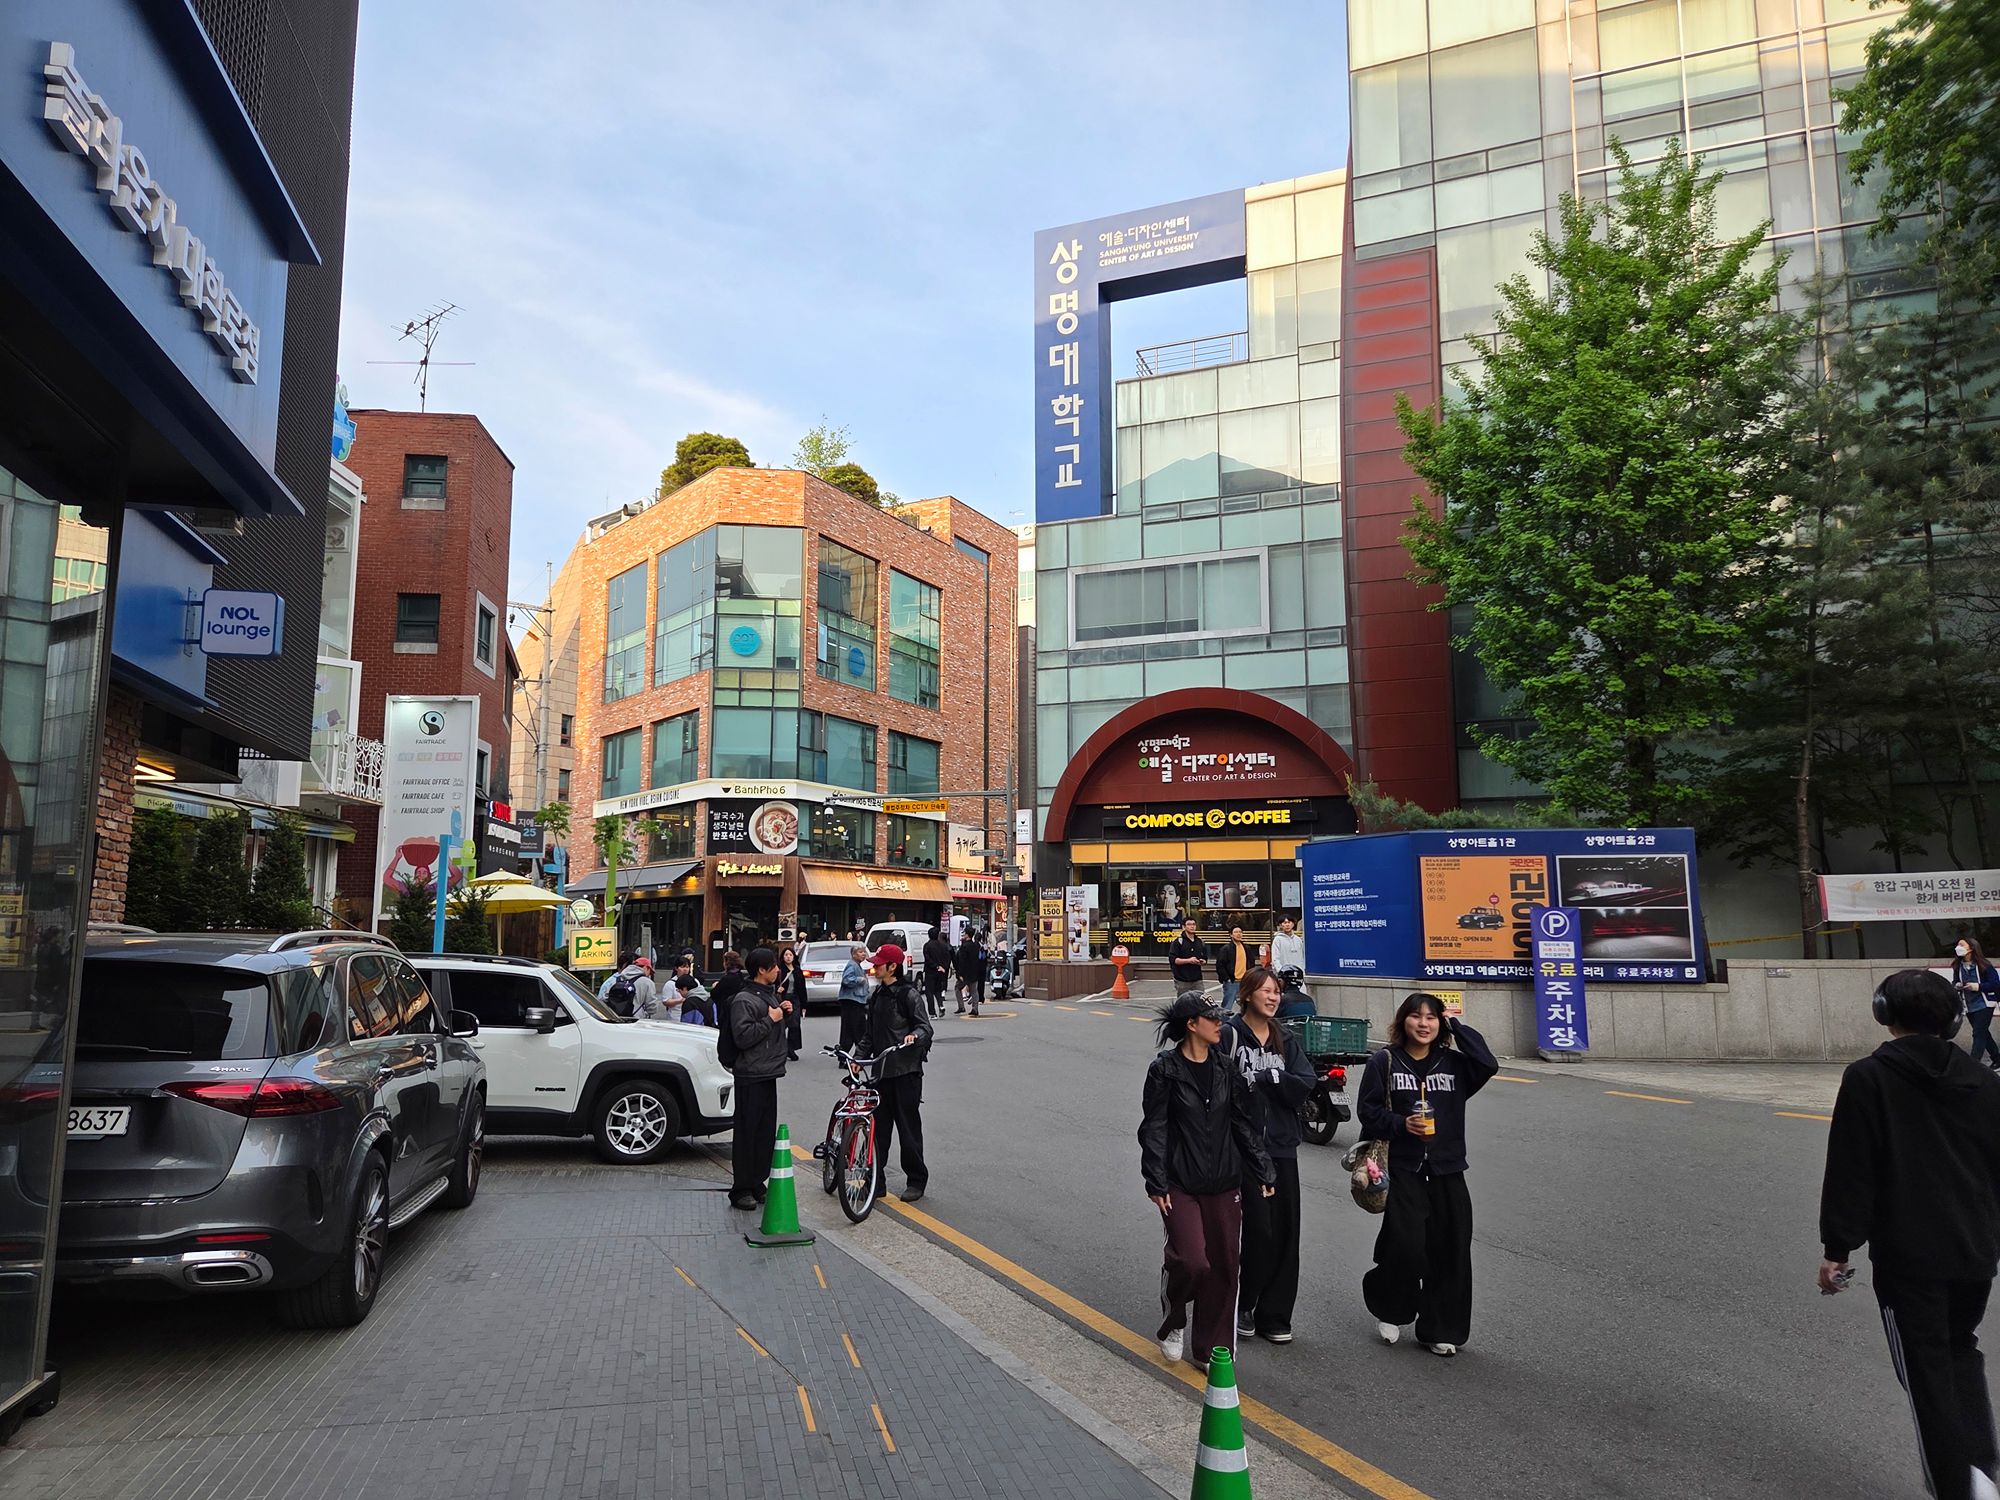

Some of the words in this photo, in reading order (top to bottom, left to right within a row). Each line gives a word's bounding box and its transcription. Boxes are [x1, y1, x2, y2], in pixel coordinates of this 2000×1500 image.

[1099, 256, 1127, 267] CENTER
[1129, 253, 1139, 261] OF
[1141, 249, 1156, 259] ART
[1165, 242, 1194, 254] DESIGN
[1100, 242, 1152, 258] SANGMYUNG
[1154, 232, 1200, 247] UNIVERSITY
[1049, 239, 1084, 490] 상명대학교
[220, 606, 260, 621] NOL
[207, 621, 271, 640] lounge
[1137, 734, 1191, 754] 상명대학교
[402, 778, 431, 786] FAIRTRADE
[1247, 771, 1277, 780] DESIGN
[336, 776, 383, 801] FAIRTRADE
[1125, 812, 1204, 829] COMPOSE
[1228, 809, 1291, 825] COFFEE
[523, 828, 537, 837] 25
[1874, 881, 1896, 892] 한갑
[1900, 879, 1934, 891] 구매시
[1938, 878, 1960, 890] 오천
[1964, 877, 1975, 889] 원
[1916, 892, 1938, 904] 한개
[1942, 891, 1976, 902] 버리면
[576, 936, 613, 959] PARKING
[1424, 965, 1475, 976] 상명대학교
[1583, 966, 1604, 978] 러리
[1539, 962, 1577, 977] 유료
[1616, 966, 1675, 978] 유료주차장
[1545, 981, 1577, 1047] 주차장
[68, 1110, 124, 1131] 8637
